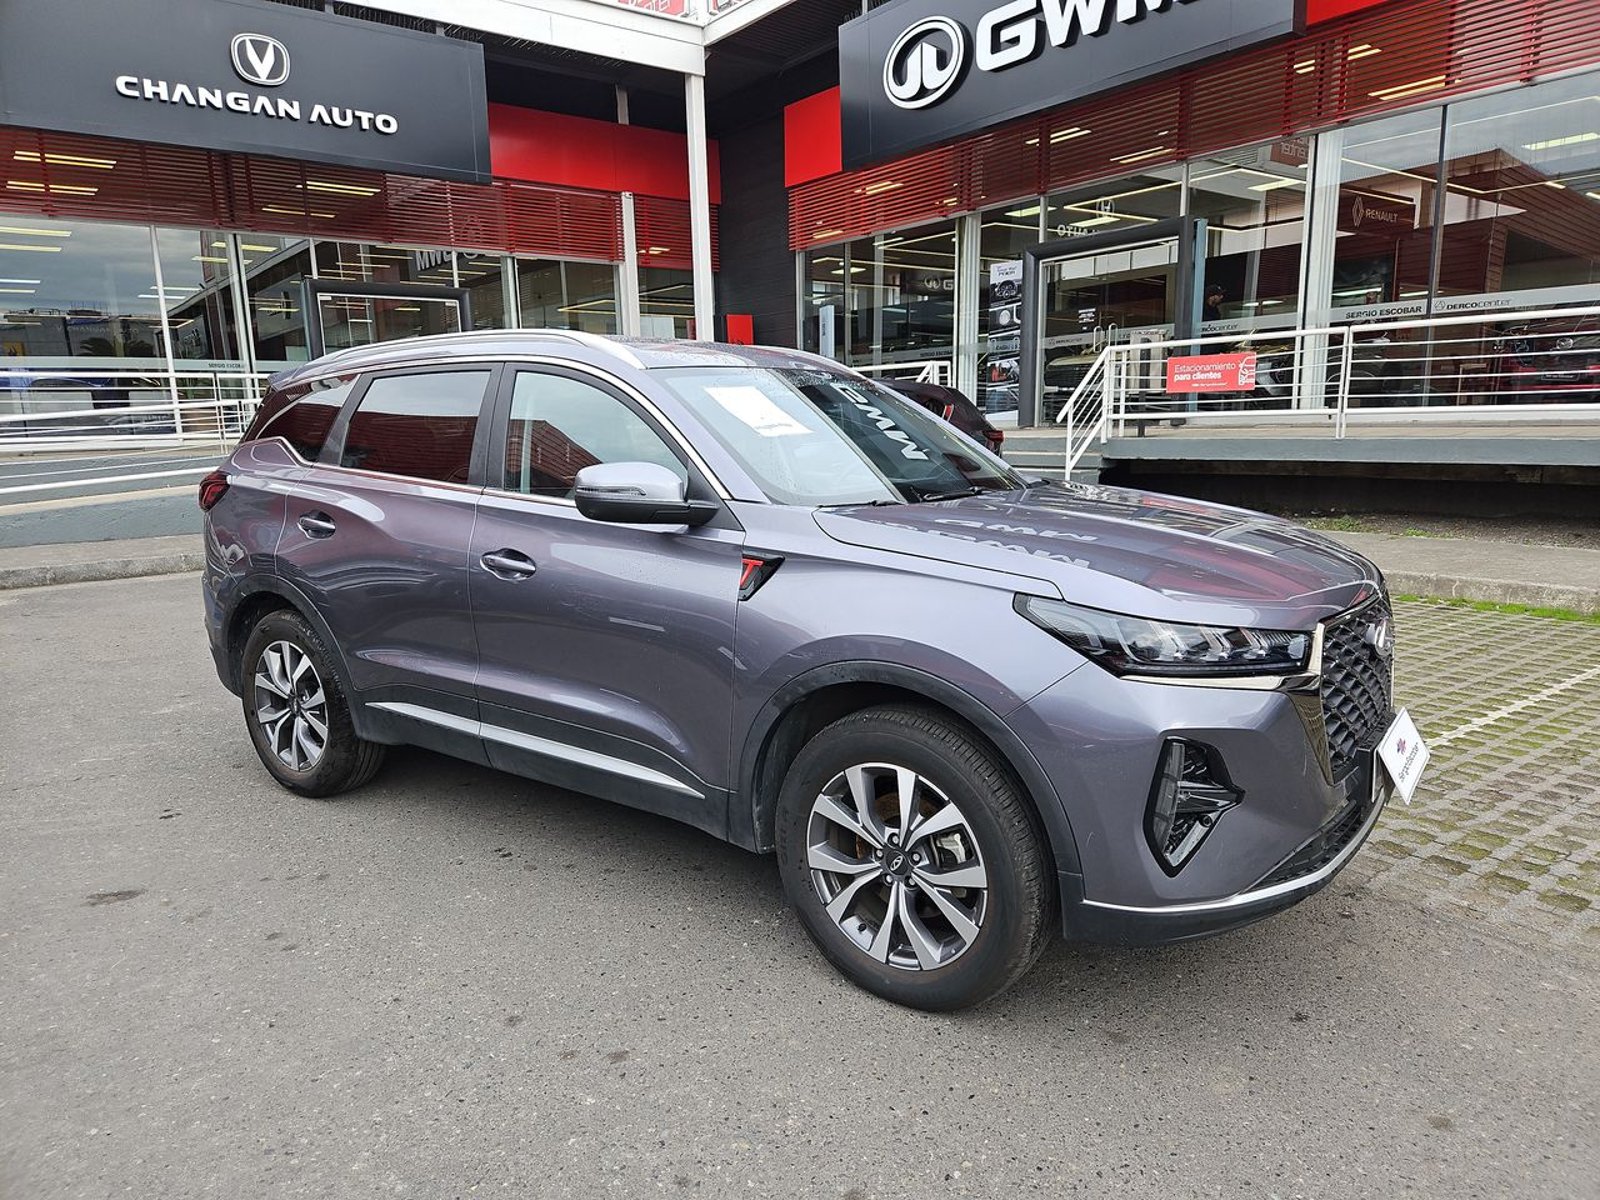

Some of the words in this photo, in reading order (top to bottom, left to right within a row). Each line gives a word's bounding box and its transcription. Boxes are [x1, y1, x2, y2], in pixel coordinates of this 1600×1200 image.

[115, 75, 301, 120] CHANGAN
[309, 104, 399, 134] AUTO
[1365, 208, 1398, 222] RENAULT
[1345, 310, 1378, 320] SERGIO
[1379, 306, 1422, 316] ESCOBAR
[1174, 362, 1236, 373] Estacionamiento
[1174, 374, 1191, 382] para
[1192, 371, 1222, 381] clientes
